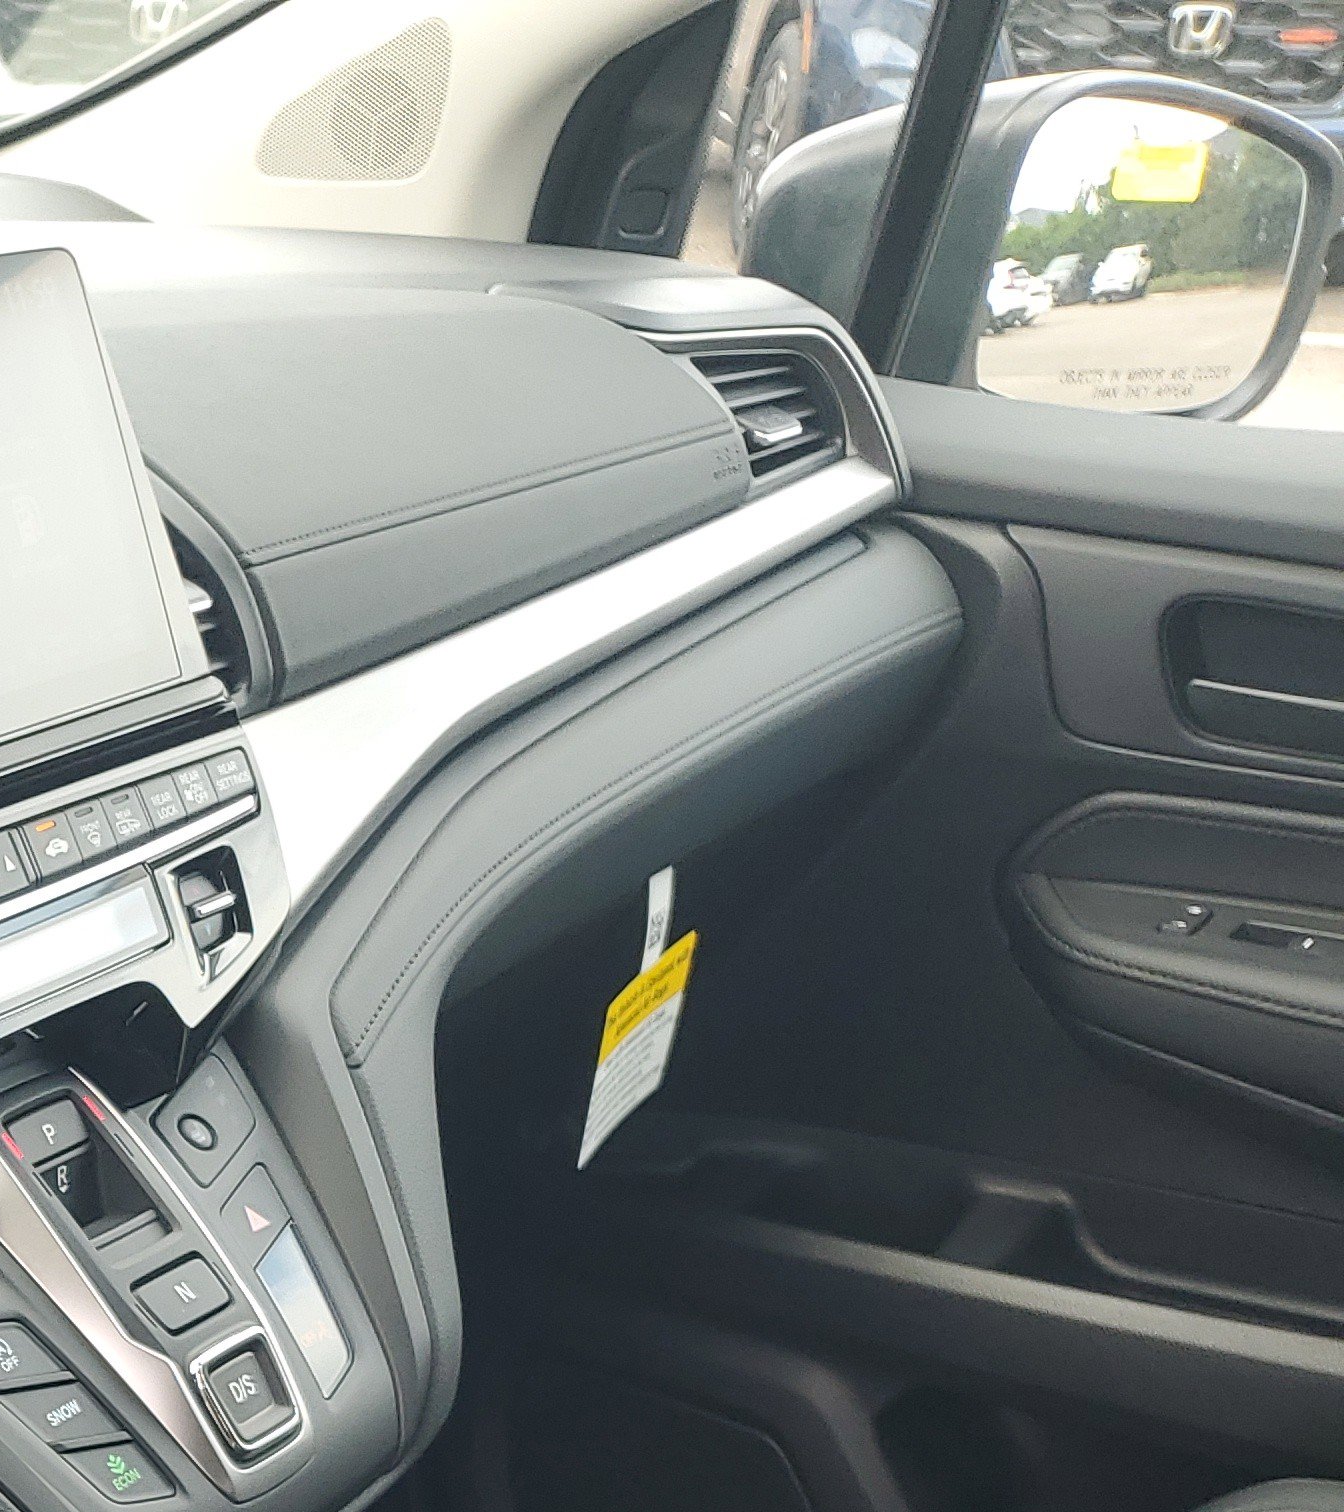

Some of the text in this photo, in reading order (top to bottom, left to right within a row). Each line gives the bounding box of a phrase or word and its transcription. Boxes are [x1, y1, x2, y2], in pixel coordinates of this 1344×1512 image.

[216, 760, 238, 775] REAR
[157, 805, 180, 820] LOCK
[41, 1123, 55, 1145] P
[57, 1165, 69, 1187] R
[173, 1281, 196, 1303] N
[0, 1355, 20, 1373] OFF
[228, 1374, 257, 1404] D/S
[46, 1399, 82, 1427] SNOW
[112, 1467, 141, 1491] ECON
